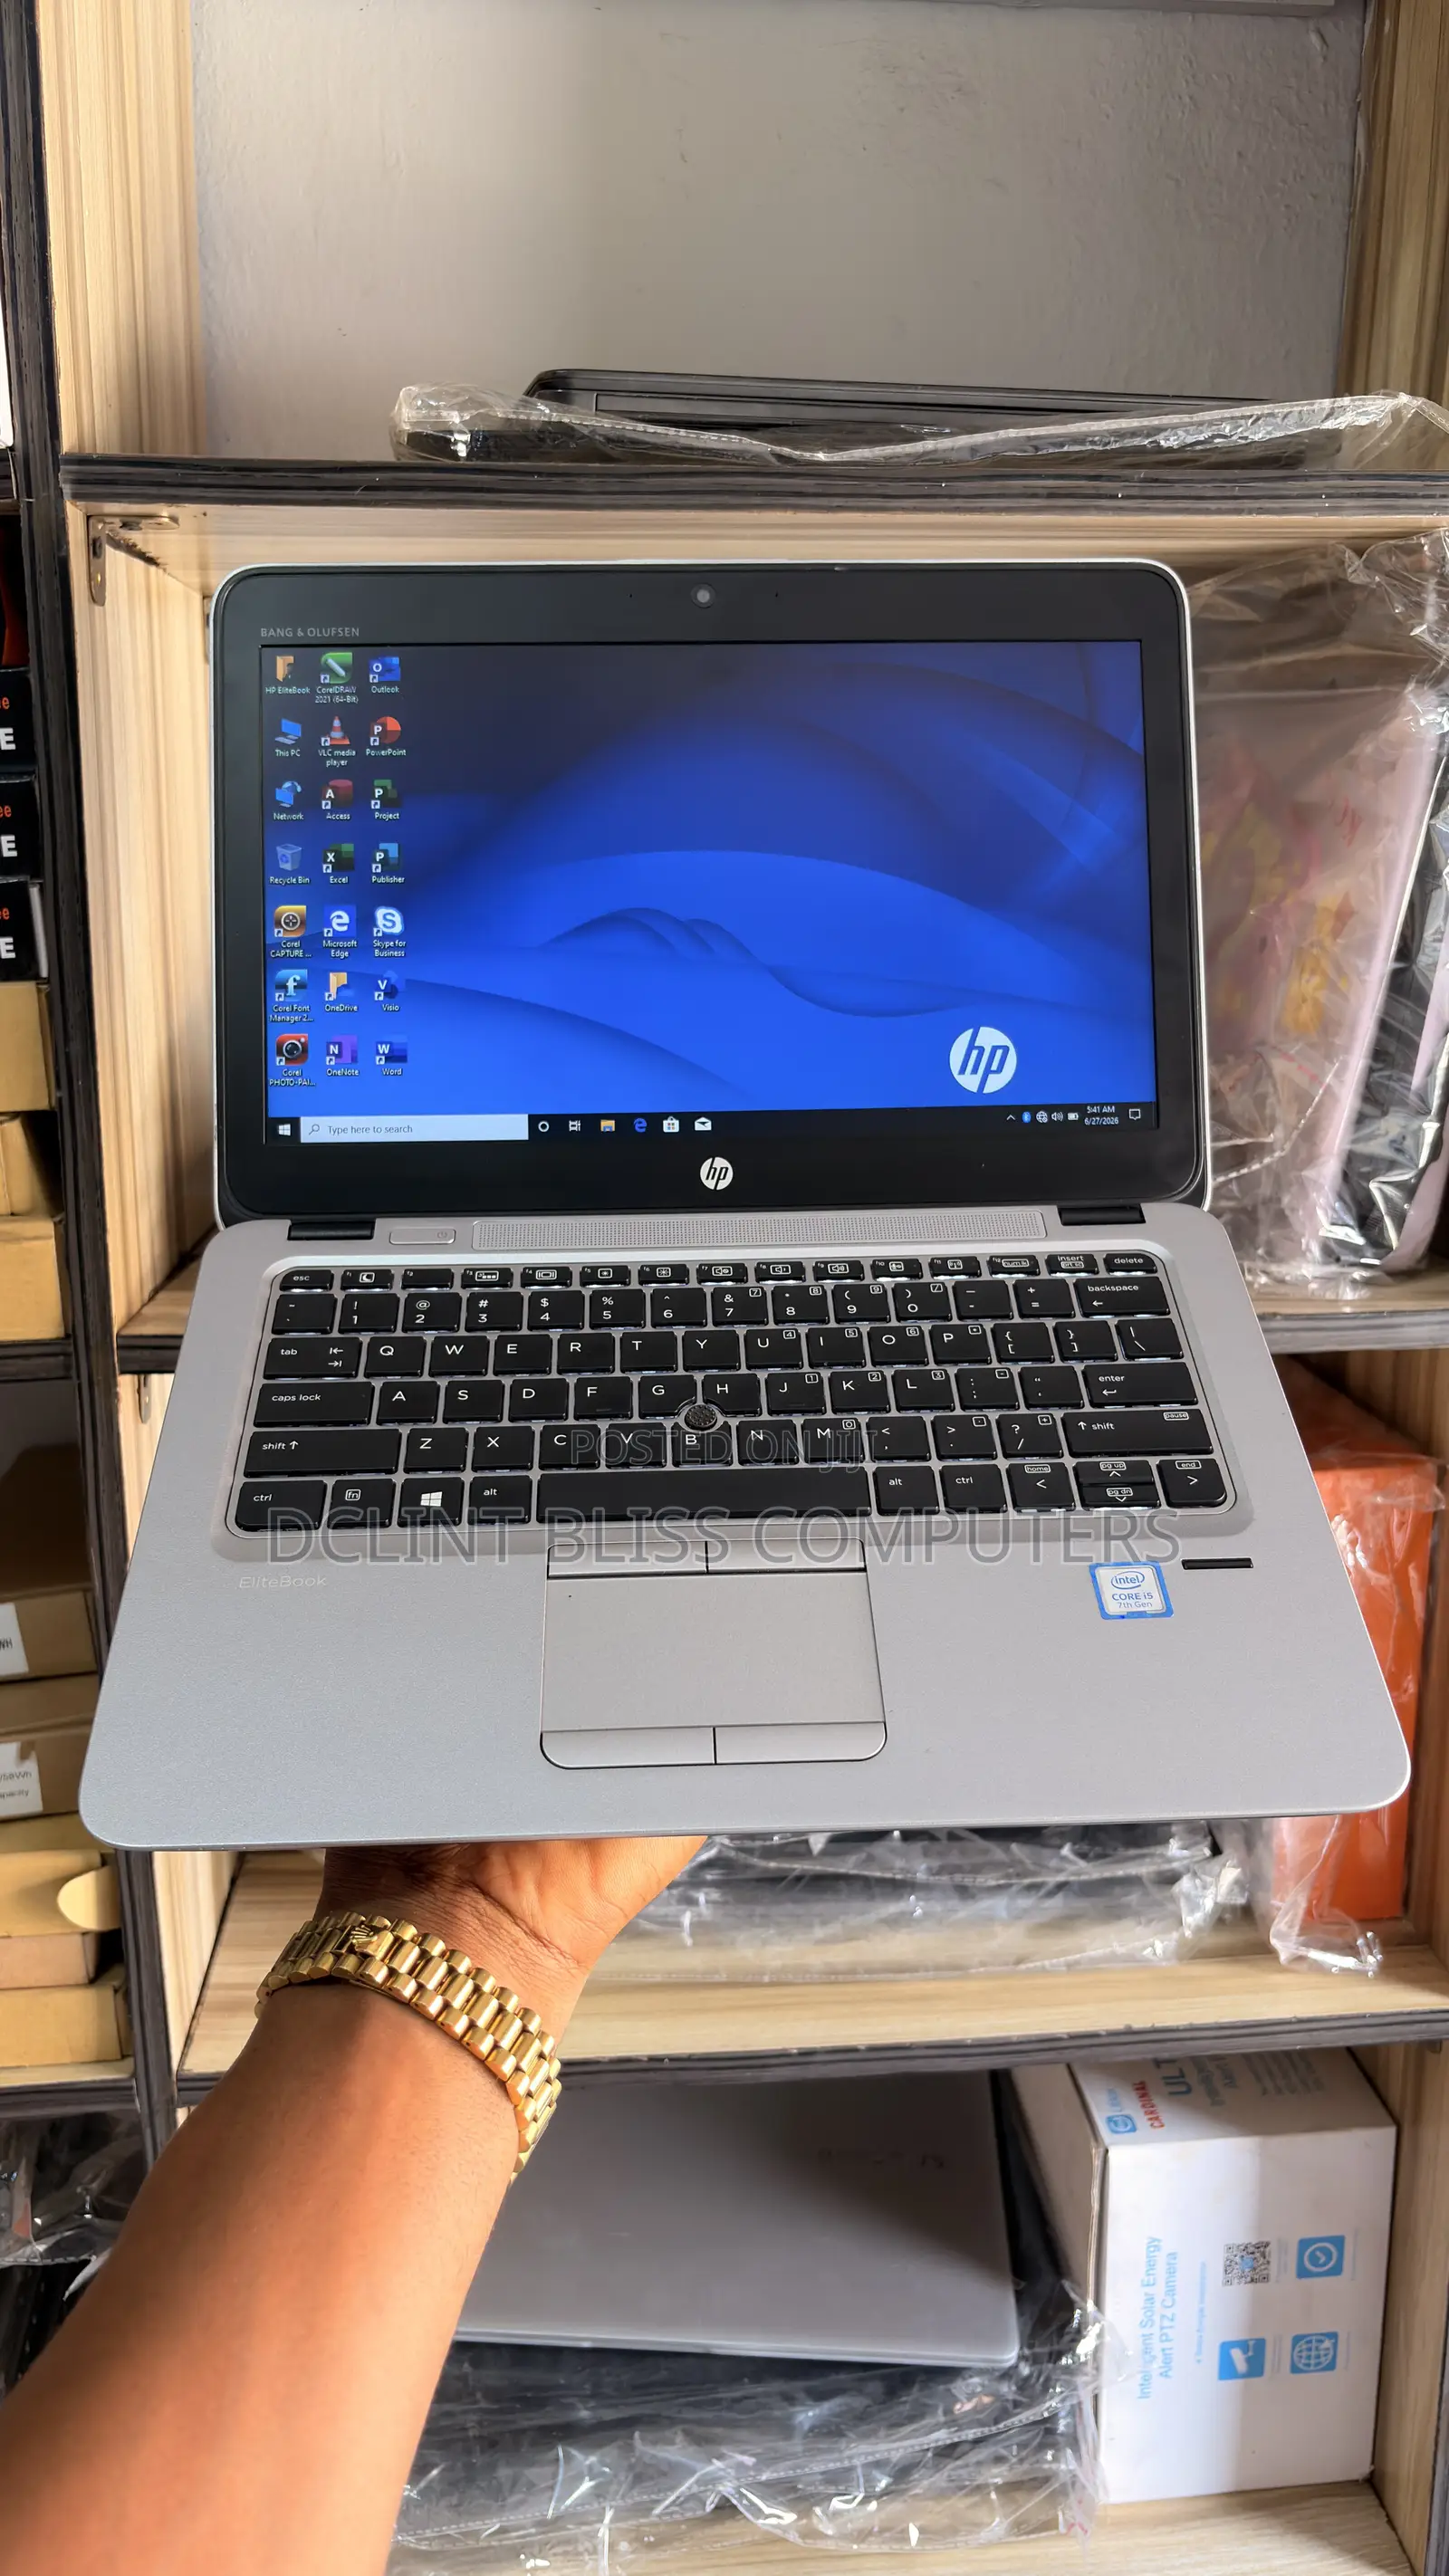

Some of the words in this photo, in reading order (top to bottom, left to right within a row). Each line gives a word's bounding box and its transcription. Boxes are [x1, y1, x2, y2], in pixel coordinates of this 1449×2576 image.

[261, 627, 293, 637] BANG
[297, 627, 304, 637] &
[307, 627, 360, 637] OLUFSEN
[277, 686, 311, 694] EliteBook
[332, 695, 359, 704] (64-Bit)
[326, 759, 348, 767] player
[375, 812, 399, 821] Project
[270, 876, 297, 885] Recycle
[372, 876, 405, 884] Publisher
[281, 940, 301, 948] Corel
[373, 940, 392, 949] Skype
[394, 939, 407, 947] for
[270, 950, 303, 958] CAPTURE
[331, 950, 349, 958] Edge
[374, 949, 405, 957] Business
[273, 1004, 292, 1012] Corel
[293, 1004, 310, 1012] Font
[382, 1003, 399, 1011] Visio
[270, 1014, 302, 1023] Manager
[956, 1027, 1011, 1093] hp
[283, 1068, 302, 1077] Corel
[382, 1068, 402, 1076] Word
[1084, 1117, 1119, 1125] 6/27/2026
[328, 1125, 347, 1135] Type
[350, 1125, 370, 1133] here
[384, 1125, 412, 1134] search
[705, 1157, 729, 1191] hp
[1088, 1284, 1139, 1293] backspace
[758, 1338, 769, 1348] U
[944, 1333, 954, 1343] P
[570, 1342, 581, 1352] R
[632, 1341, 642, 1351] T
[696, 1339, 708, 1349] Y
[379, 1345, 394, 1355] Q
[446, 1345, 464, 1355] W
[507, 1345, 517, 1354] E
[1099, 1374, 1125, 1383] enter
[717, 1384, 728, 1394] H
[780, 1383, 787, 1393] J
[843, 1381, 855, 1391] K
[907, 1379, 917, 1389] L
[523, 1389, 535, 1399] D
[587, 1387, 598, 1397] F
[652, 1384, 665, 1396] G
[272, 1394, 296, 1403] caps
[299, 1393, 321, 1402] lock
[392, 1391, 406, 1402] A
[457, 1390, 468, 1401] S
[1091, 1422, 1115, 1431] shift
[620, 1432, 634, 1444] V
[751, 1430, 763, 1441] N
[817, 1428, 830, 1439] M
[420, 1439, 432, 1449] Z
[487, 1437, 500, 1448] X
[554, 1434, 567, 1445] C
[686, 1434, 697, 1445] B
[262, 1441, 286, 1451] shift
[889, 1478, 902, 1486] alt
[955, 1476, 973, 1484] ctrl
[254, 1493, 272, 1501] ctrl
[484, 1488, 497, 1496] alt
[239, 1575, 327, 1589] EliteBook
[1114, 1575, 1140, 1585] intel
[1111, 1593, 1140, 1601] CORE
[1118, 1601, 1133, 1609] 7th
[1133, 2080, 1166, 2131] CARDINAL
[1141, 2236, 1163, 2286] Energy
[1162, 2252, 1178, 2309] Camera
[1138, 2292, 1156, 2329] Solar
[1160, 2313, 1176, 2342] PTZ
[1137, 2332, 1156, 2399] Intelgent
[1158, 2347, 1174, 2379] Alert
